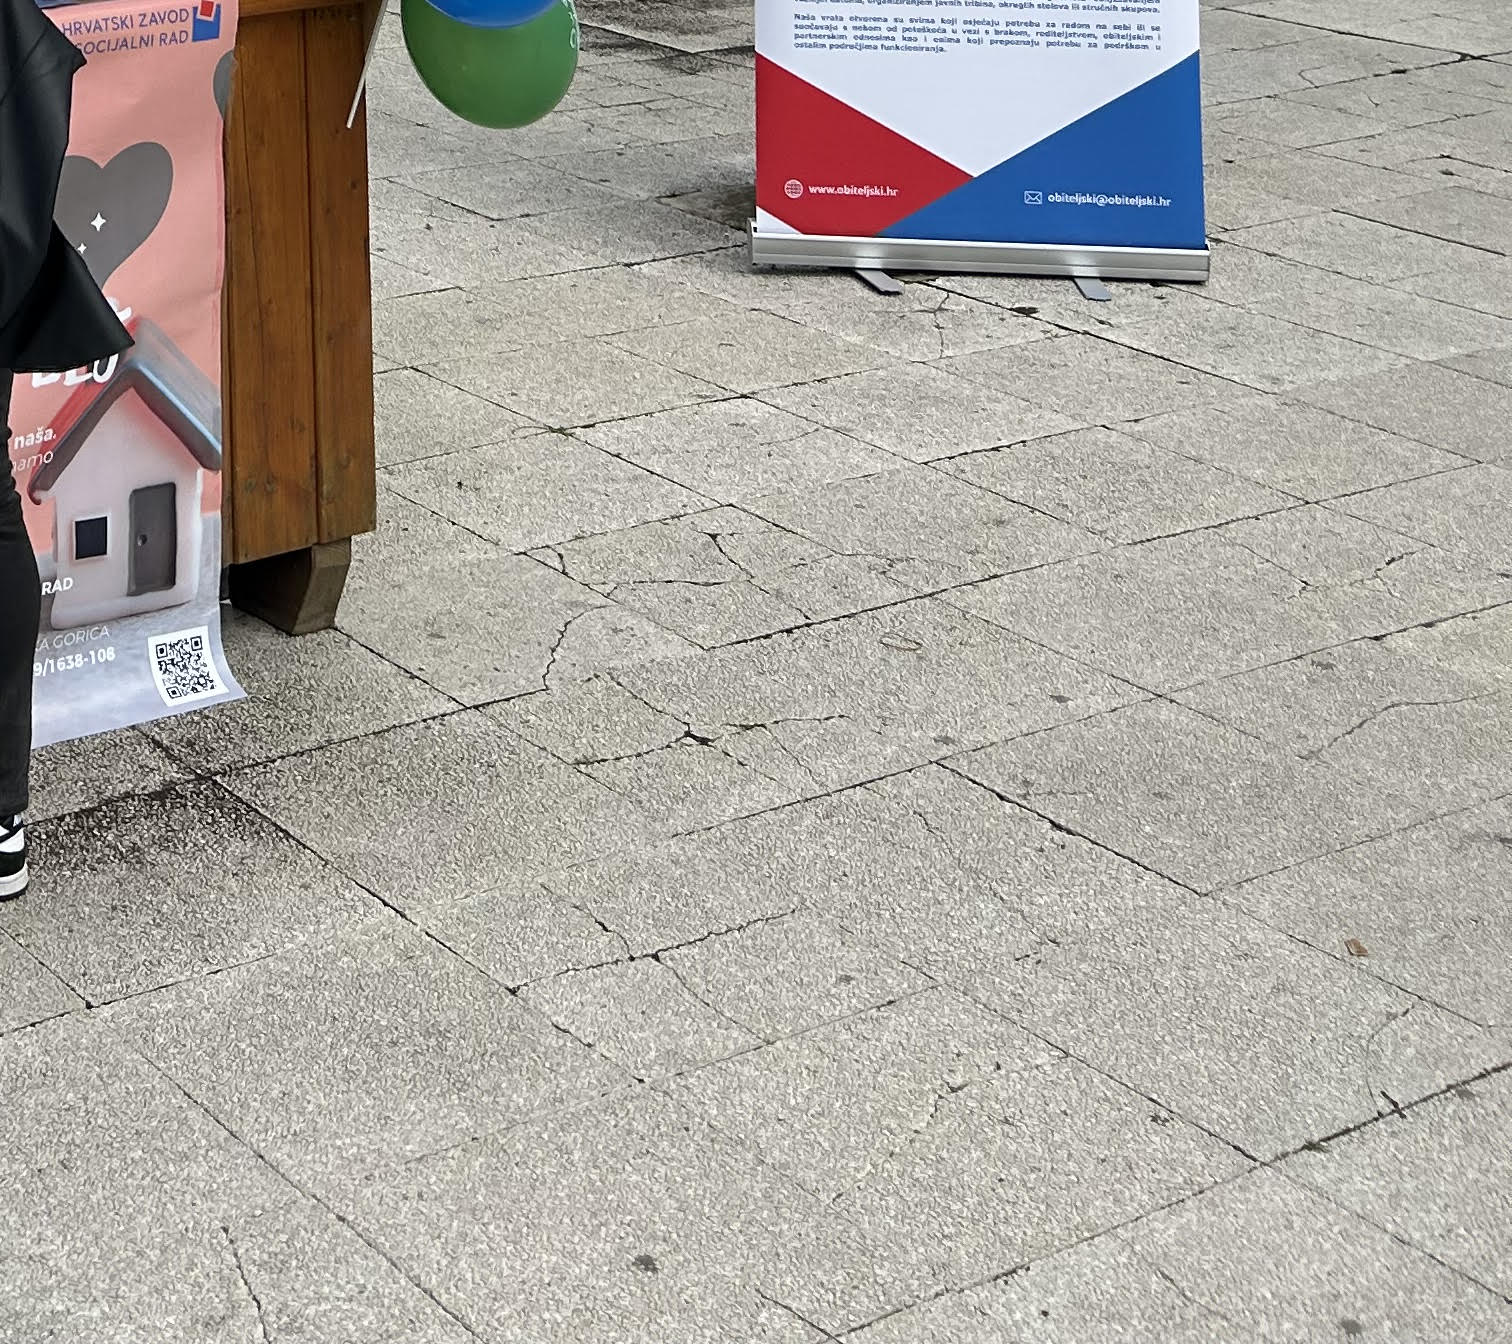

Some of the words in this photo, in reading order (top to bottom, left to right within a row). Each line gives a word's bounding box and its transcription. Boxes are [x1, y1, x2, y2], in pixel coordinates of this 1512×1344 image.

[62, 14, 134, 37] HRVATSKI
[138, 8, 189, 28] ZAVOD
[159, 30, 188, 47] RAD
[808, 183, 899, 198] www.obiteljski.hr
[1047, 192, 1171, 208] obiteljski@obiteljski.hr
[14, 426, 57, 450] naša.
[41, 576, 74, 596] RAD
[53, 624, 111, 649] GORICA
